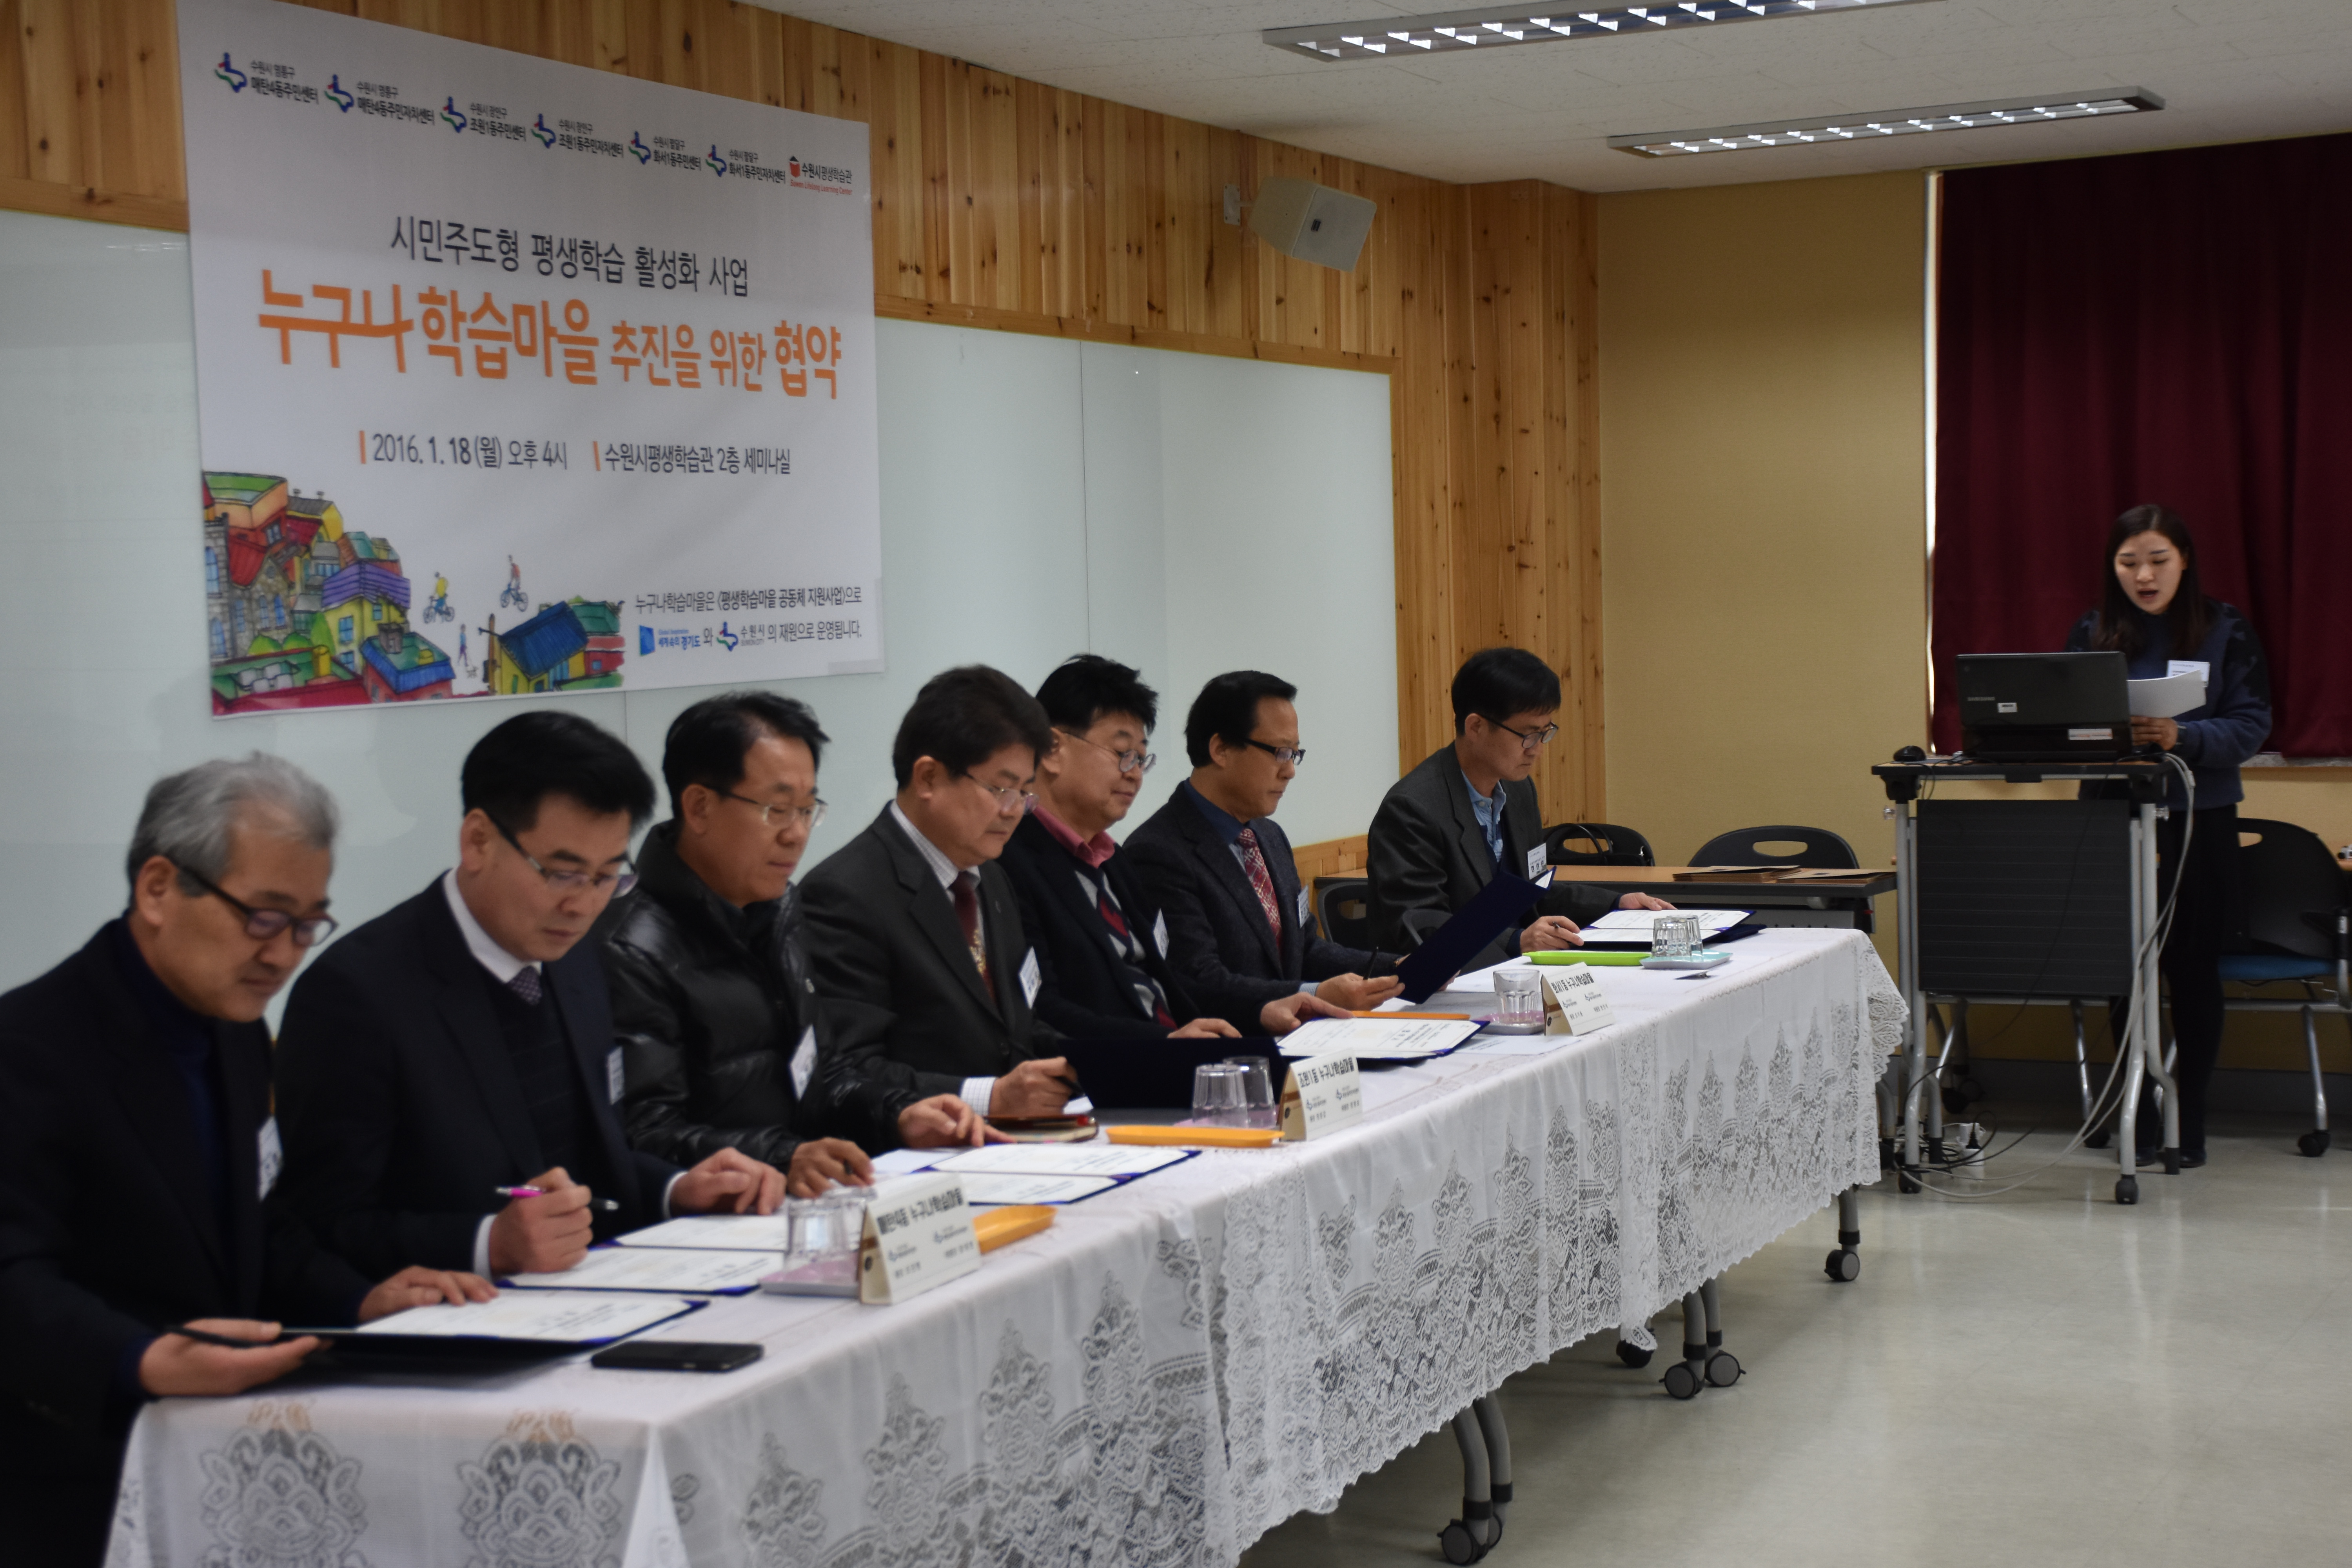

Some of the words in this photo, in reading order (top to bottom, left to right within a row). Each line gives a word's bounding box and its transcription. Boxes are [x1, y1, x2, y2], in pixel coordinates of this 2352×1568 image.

[801, 162, 852, 184] 수원시평생학습관
[391, 216, 519, 272] 시민주도형
[531, 234, 625, 284] 평생학습
[635, 246, 700, 292] 활성화
[709, 256, 748, 297] 사업
[611, 320, 701, 388] 추진을
[710, 329, 767, 392] 위한
[774, 320, 841, 399] 협약
[508, 440, 539, 468] 오후
[542, 441, 567, 470] 4시
[605, 443, 714, 473] 수원시평생학습관
[717, 446, 740, 474] 2층
[743, 448, 790, 475] 세미나실
[635, 591, 715, 614] 누구나학습마을은
[779, 588, 805, 608] 공동체
[681, 635, 701, 650] 경기도
[703, 628, 713, 646] 와
[740, 624, 765, 638] 수원시
[768, 624, 777, 642] 의
[779, 622, 815, 642] 재원으로
[817, 620, 862, 641] 운영됩니다.
[1565, 972, 1595, 990] 누구나학습마을
[1298, 1068, 1319, 1088] 조원1동
[1319, 1057, 1355, 1081] 누구나학습마을
[911, 1187, 963, 1221] 누구나학습마을
